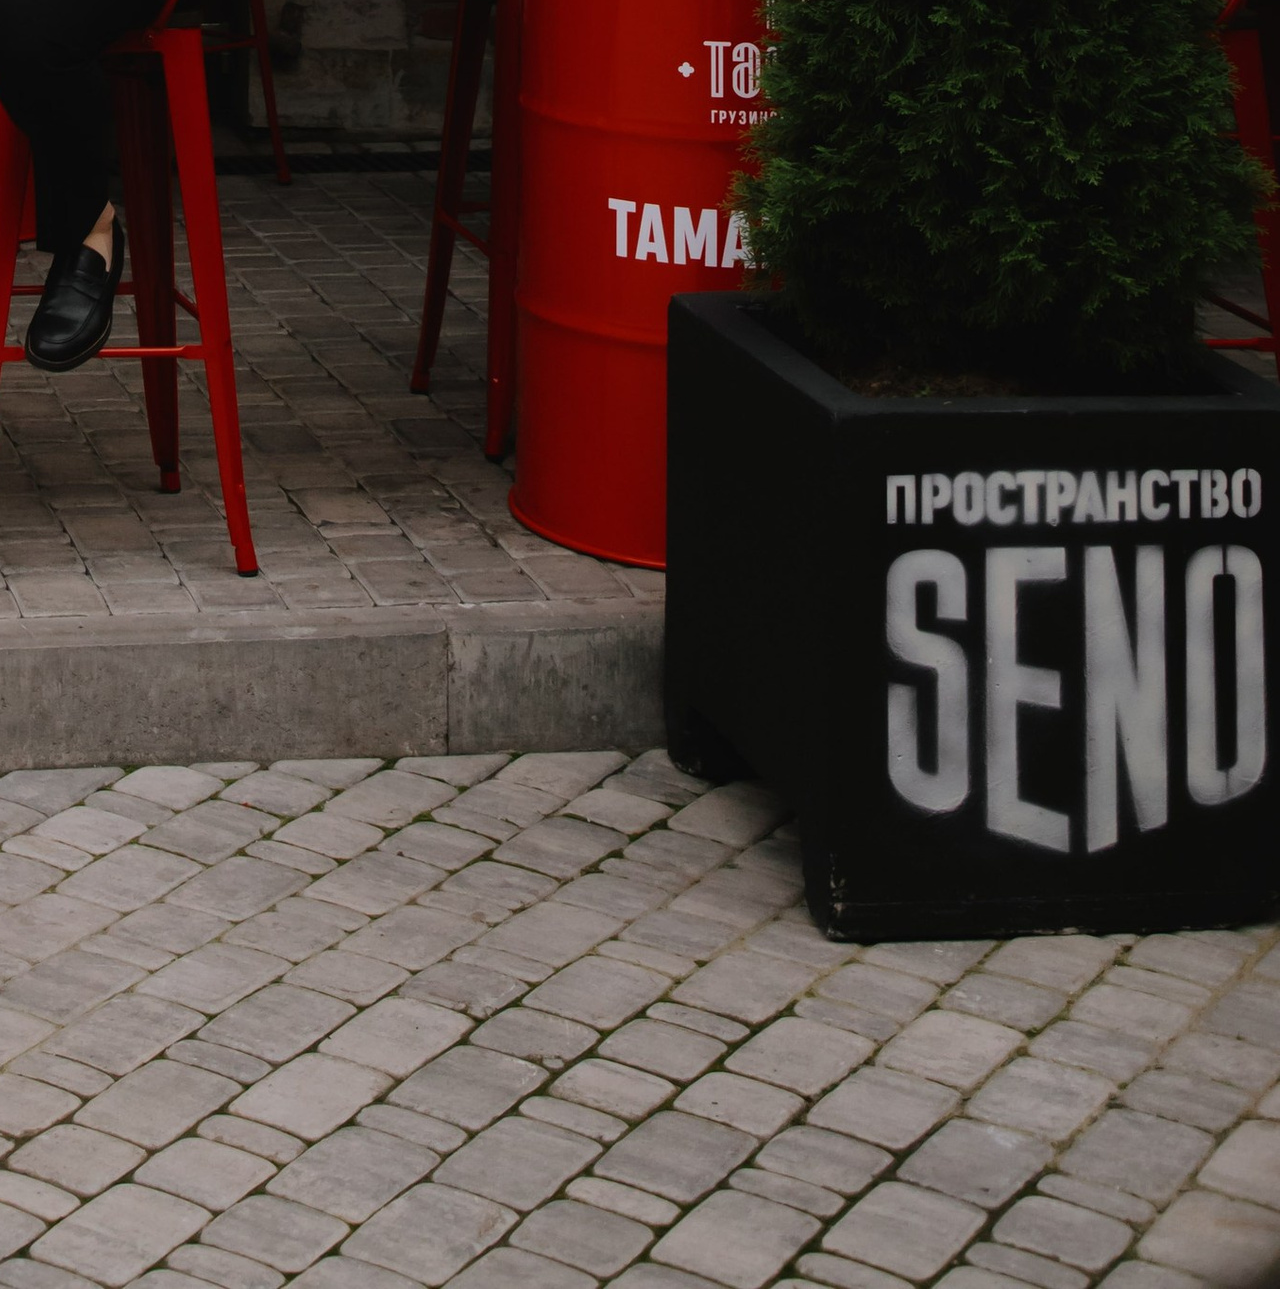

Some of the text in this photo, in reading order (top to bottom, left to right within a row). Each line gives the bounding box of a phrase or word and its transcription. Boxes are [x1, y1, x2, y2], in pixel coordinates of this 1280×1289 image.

[608, 197, 770, 269] ТАМА
[886, 468, 1262, 526] ПРОСТРАНСТВО
[886, 544, 1267, 854] SENO
